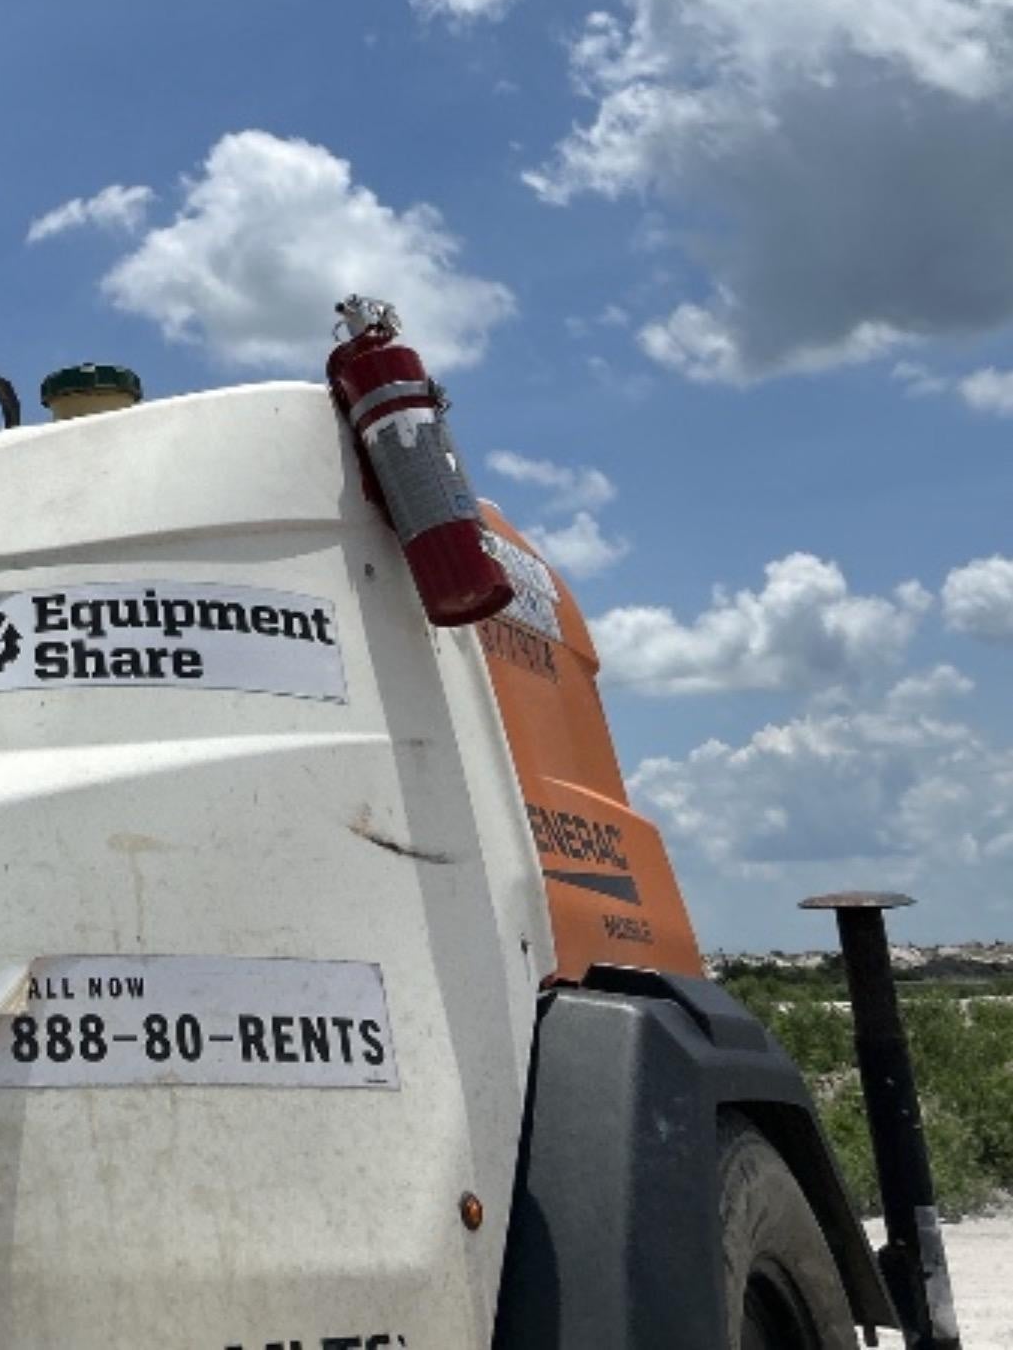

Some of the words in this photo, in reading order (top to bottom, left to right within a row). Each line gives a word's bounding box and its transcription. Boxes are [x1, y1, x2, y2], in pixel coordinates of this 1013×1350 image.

[32, 590, 335, 645] Equipment
[34, 641, 203, 679] Share
[526, 804, 628, 870] ENERAC
[28, 977, 75, 1000] ALL
[89, 977, 144, 999] NOW
[11, 1013, 384, 1066] 888-80-RENTS
